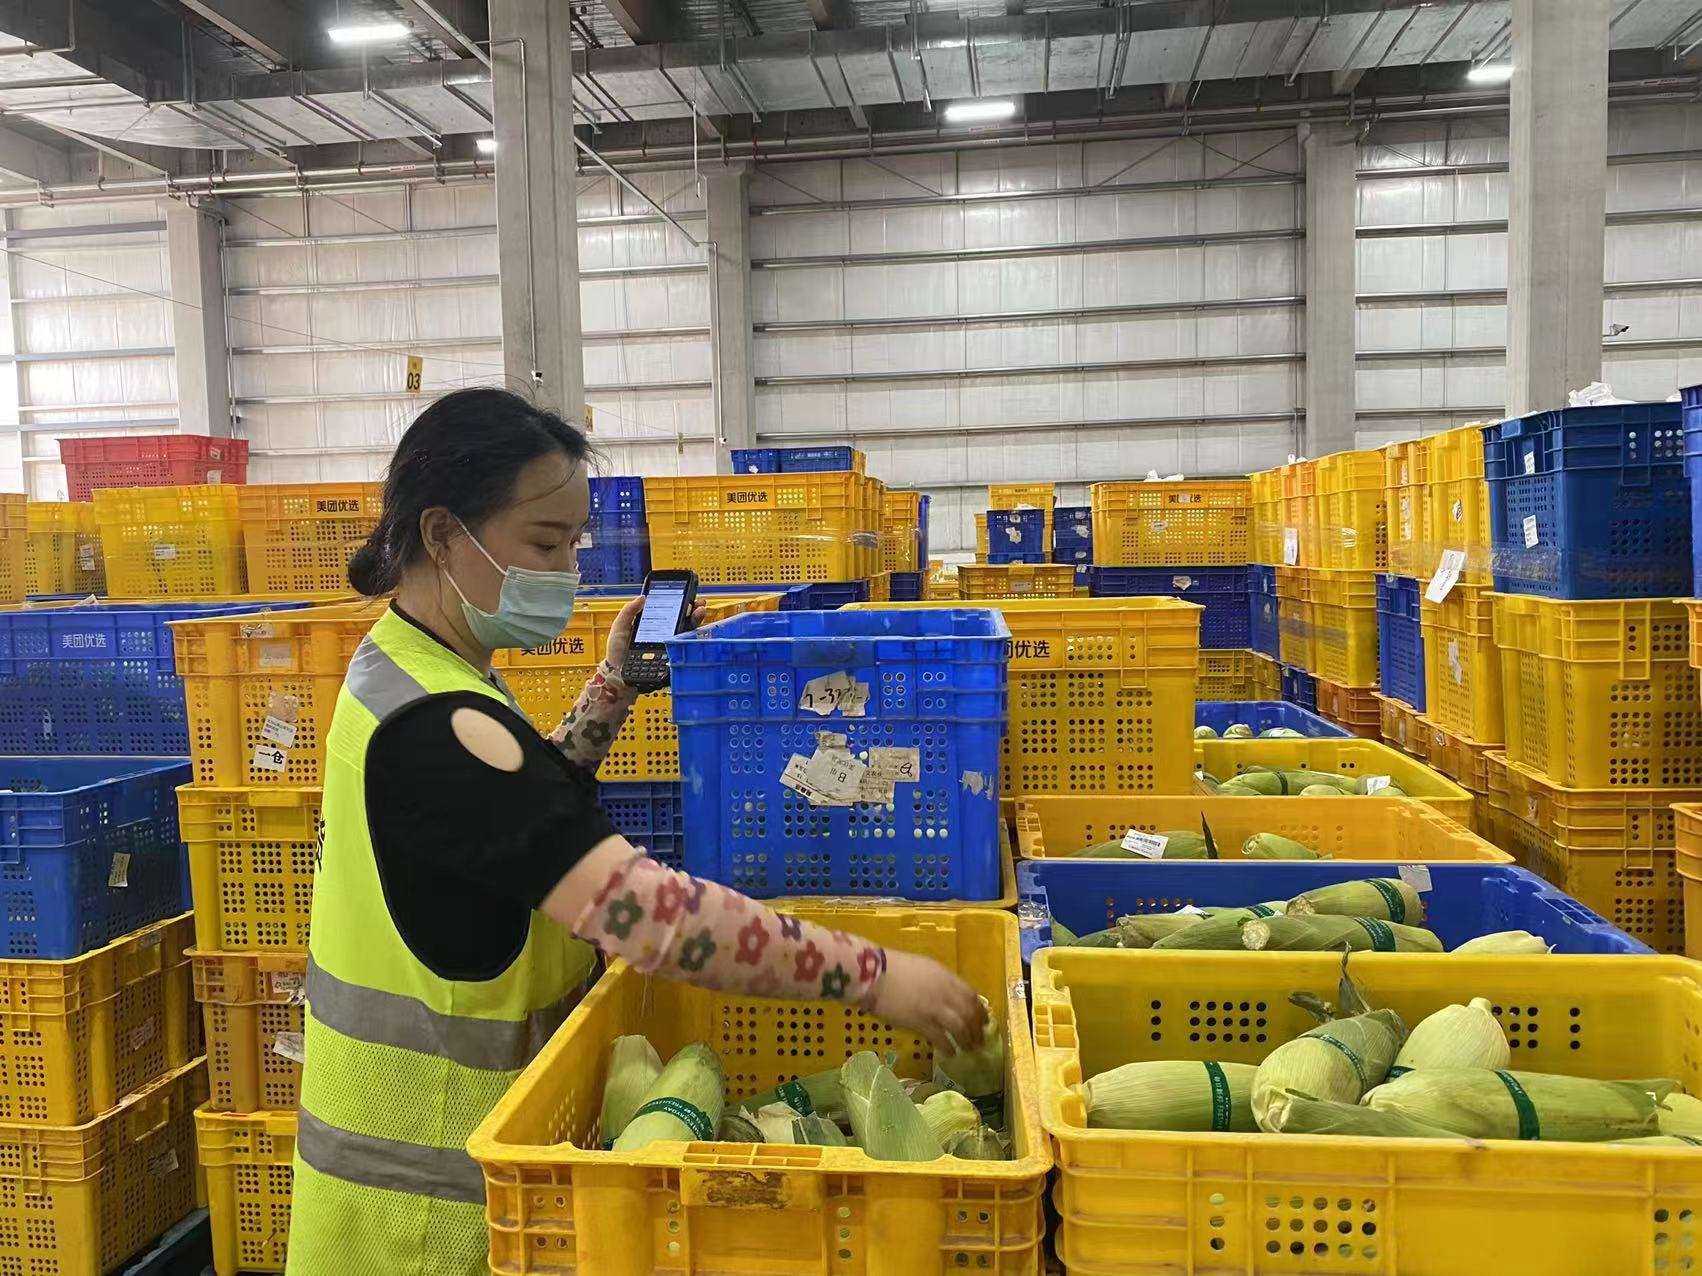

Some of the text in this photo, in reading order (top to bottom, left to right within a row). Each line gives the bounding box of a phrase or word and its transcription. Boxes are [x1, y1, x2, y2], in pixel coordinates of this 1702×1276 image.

[407, 372, 421, 389] 03
[727, 491, 768, 503] 美团优选
[317, 500, 359, 512] 美团优选
[62, 633, 107, 648] 美团优选
[521, 637, 584, 656] 团优选
[258, 750, 284, 765] 一仓
